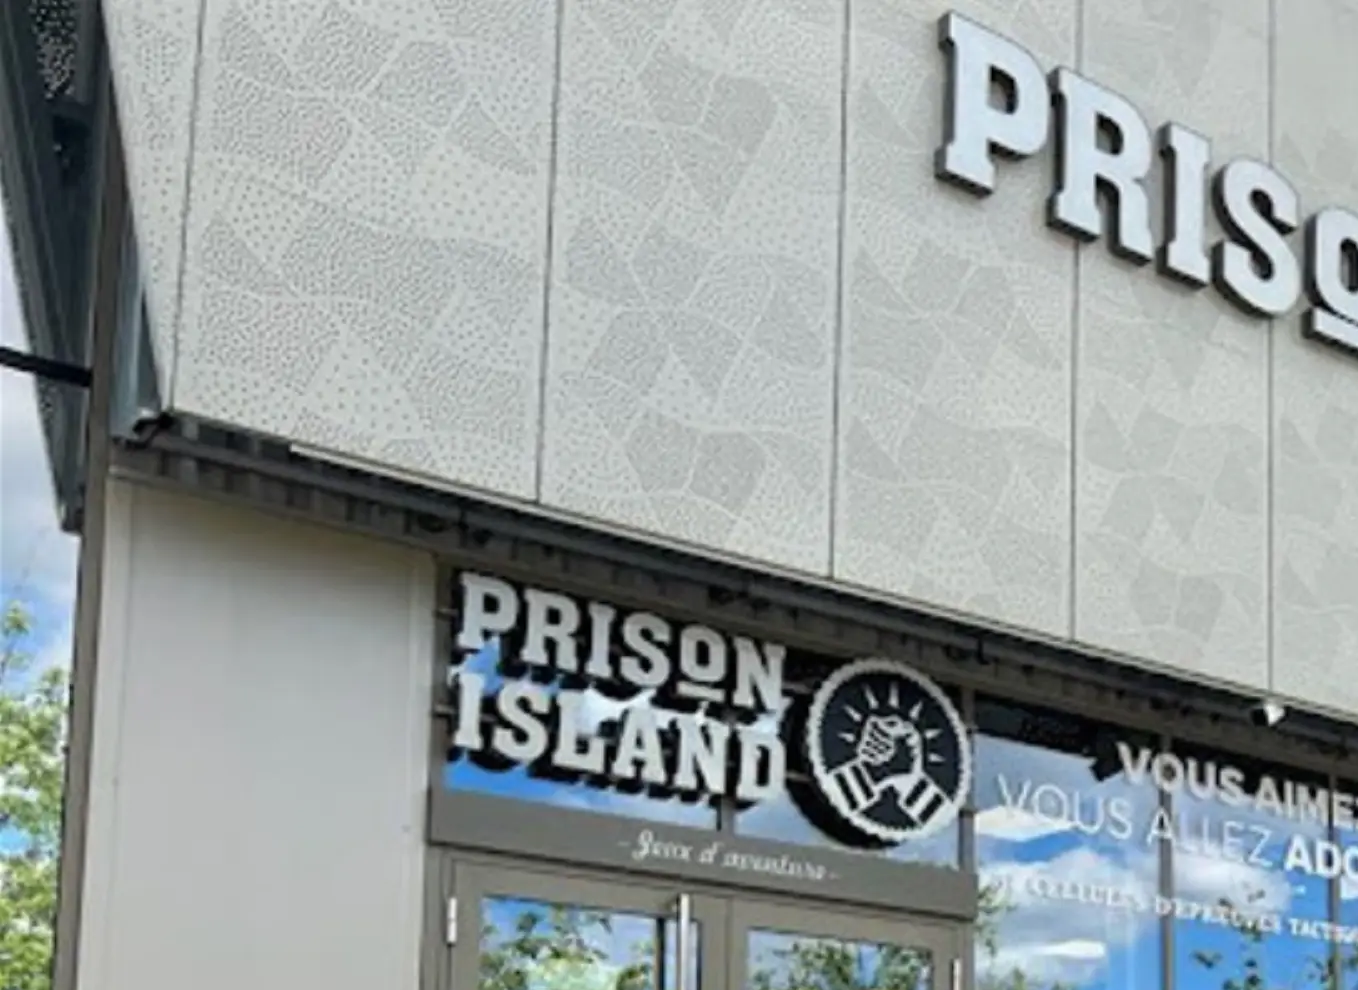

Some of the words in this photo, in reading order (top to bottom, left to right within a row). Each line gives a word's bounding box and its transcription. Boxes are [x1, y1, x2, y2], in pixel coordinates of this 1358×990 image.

[457, 573, 787, 711] PRISON
[453, 667, 787, 800] ISLAND
[1117, 742, 1246, 806] VOUS
[997, 773, 1133, 841] VOUS
[1147, 808, 1273, 868] ALLEZ
